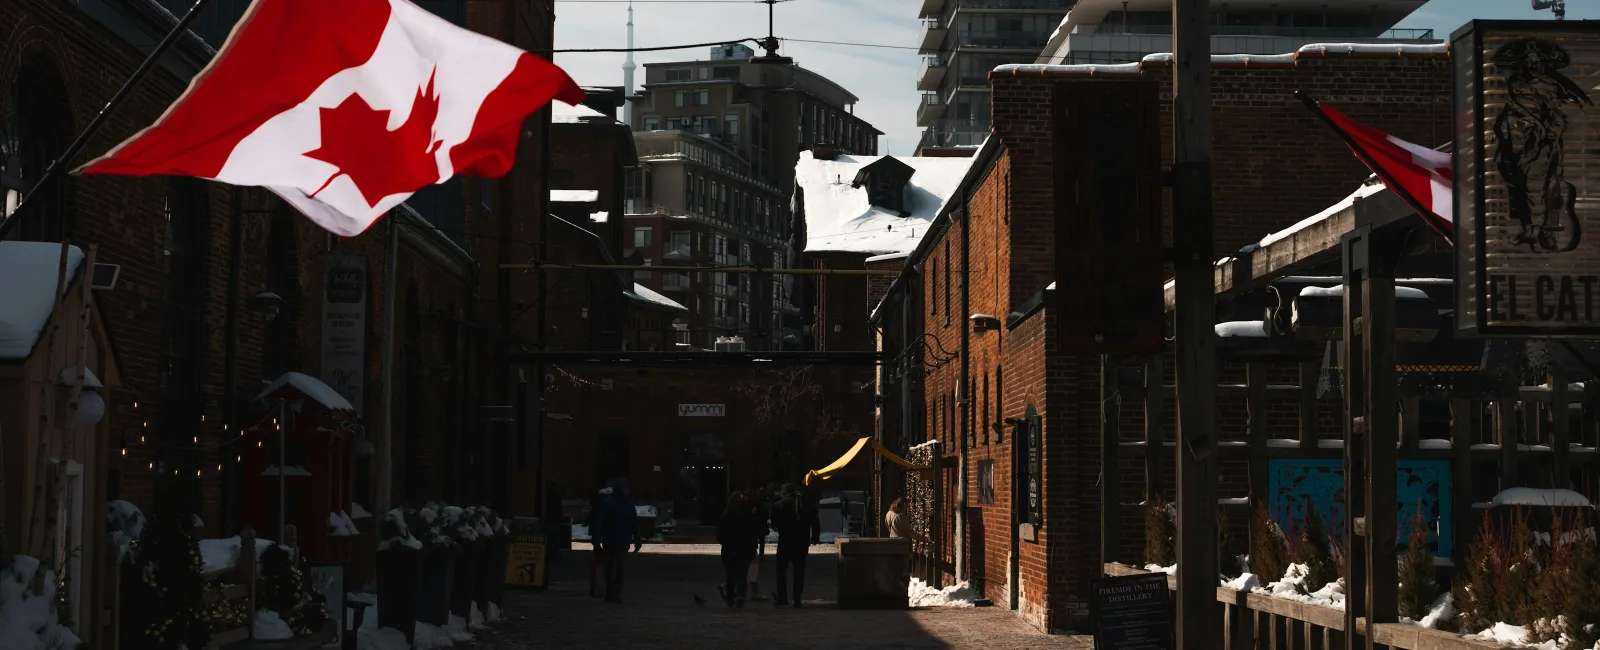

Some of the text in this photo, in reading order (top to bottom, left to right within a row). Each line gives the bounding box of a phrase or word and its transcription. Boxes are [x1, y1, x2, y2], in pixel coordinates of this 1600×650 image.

[1490, 275, 1526, 321] EL
[680, 405, 722, 416] yummi
[1098, 582, 1161, 595] FIRESIDE IN THE
[1109, 592, 1153, 603] DISTILLERY
